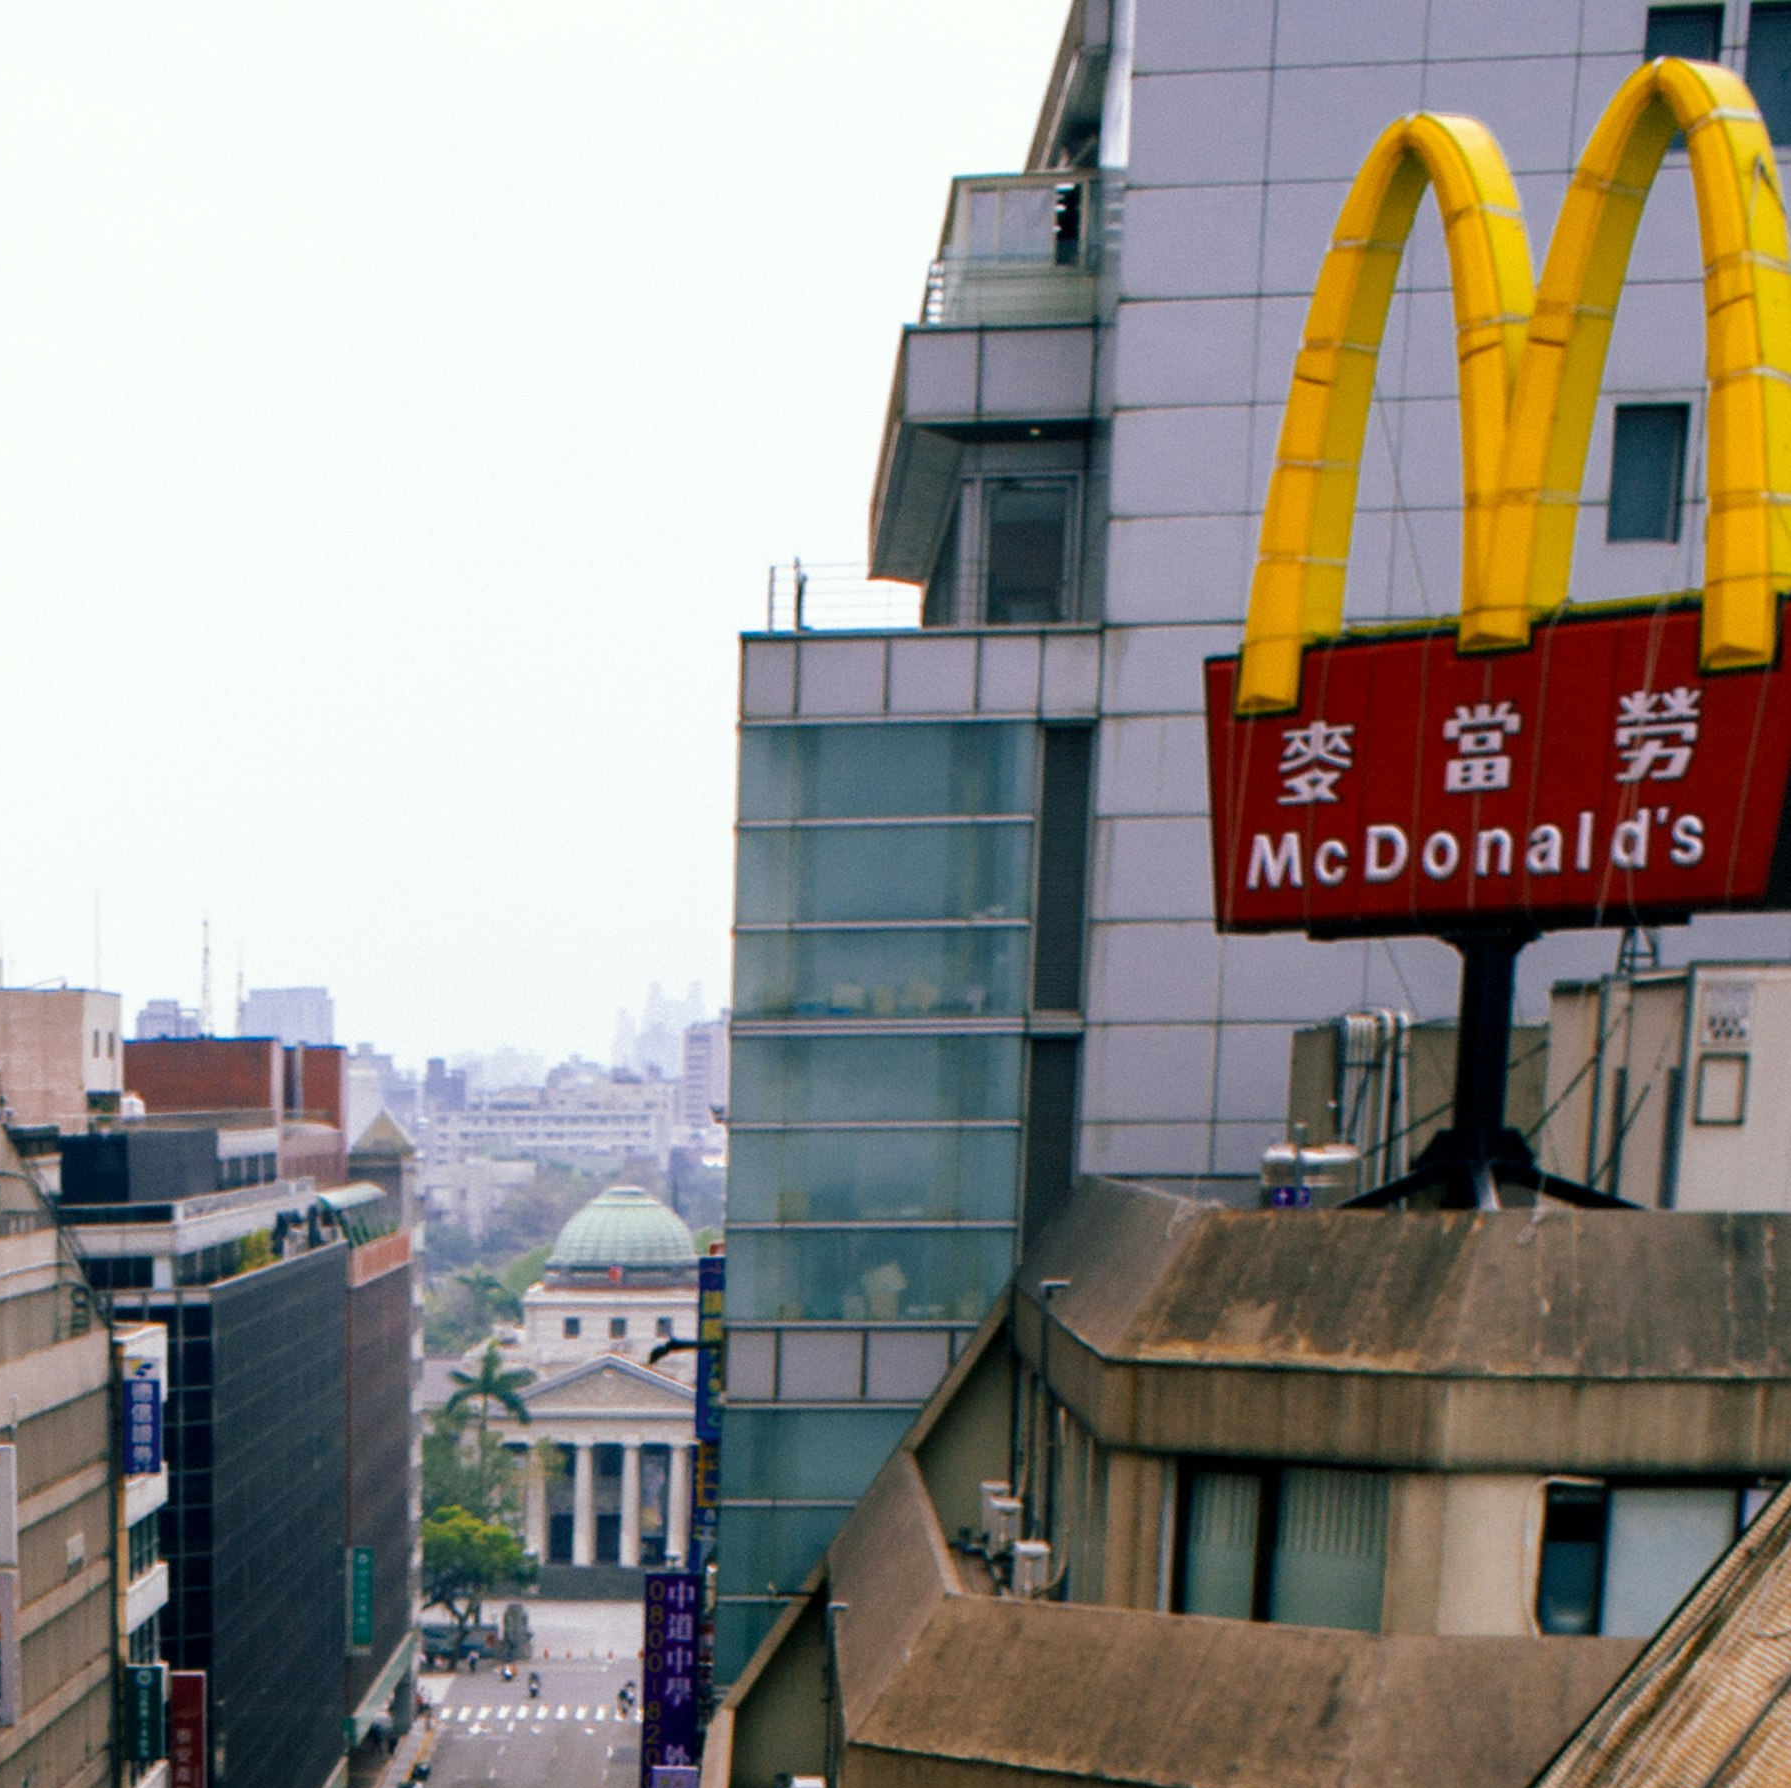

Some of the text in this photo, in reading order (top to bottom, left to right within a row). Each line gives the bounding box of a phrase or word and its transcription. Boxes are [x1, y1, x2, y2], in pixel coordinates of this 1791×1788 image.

[1277, 686, 1703, 806] 麥當勞
[1245, 806, 1706, 891] McDonald's
